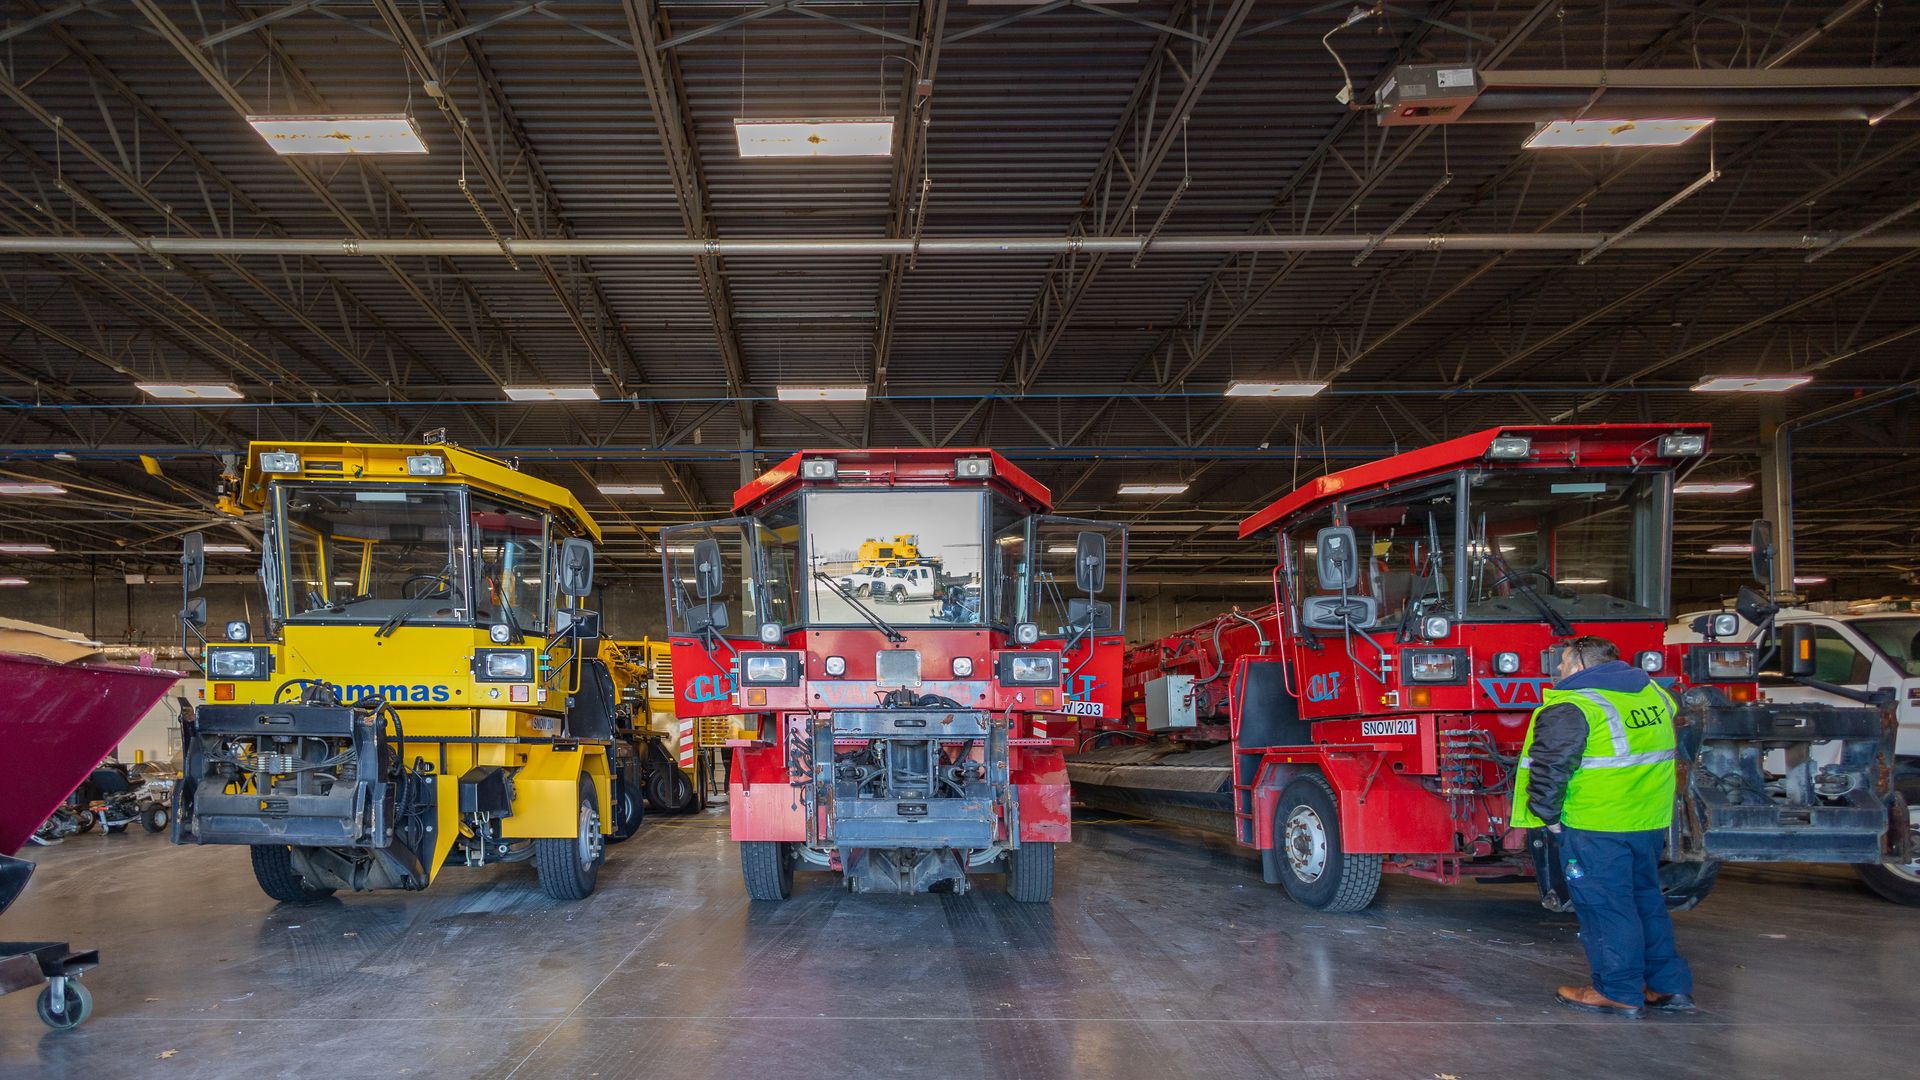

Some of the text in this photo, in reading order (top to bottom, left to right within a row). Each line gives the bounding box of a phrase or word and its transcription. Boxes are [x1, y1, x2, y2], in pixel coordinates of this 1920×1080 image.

[1067, 674, 1096, 701] LT
[1312, 672, 1339, 702] CLT
[1077, 702, 1101, 716] 203
[1630, 706, 1661, 727] CLT
[1363, 720, 1415, 735] SNOW 201
